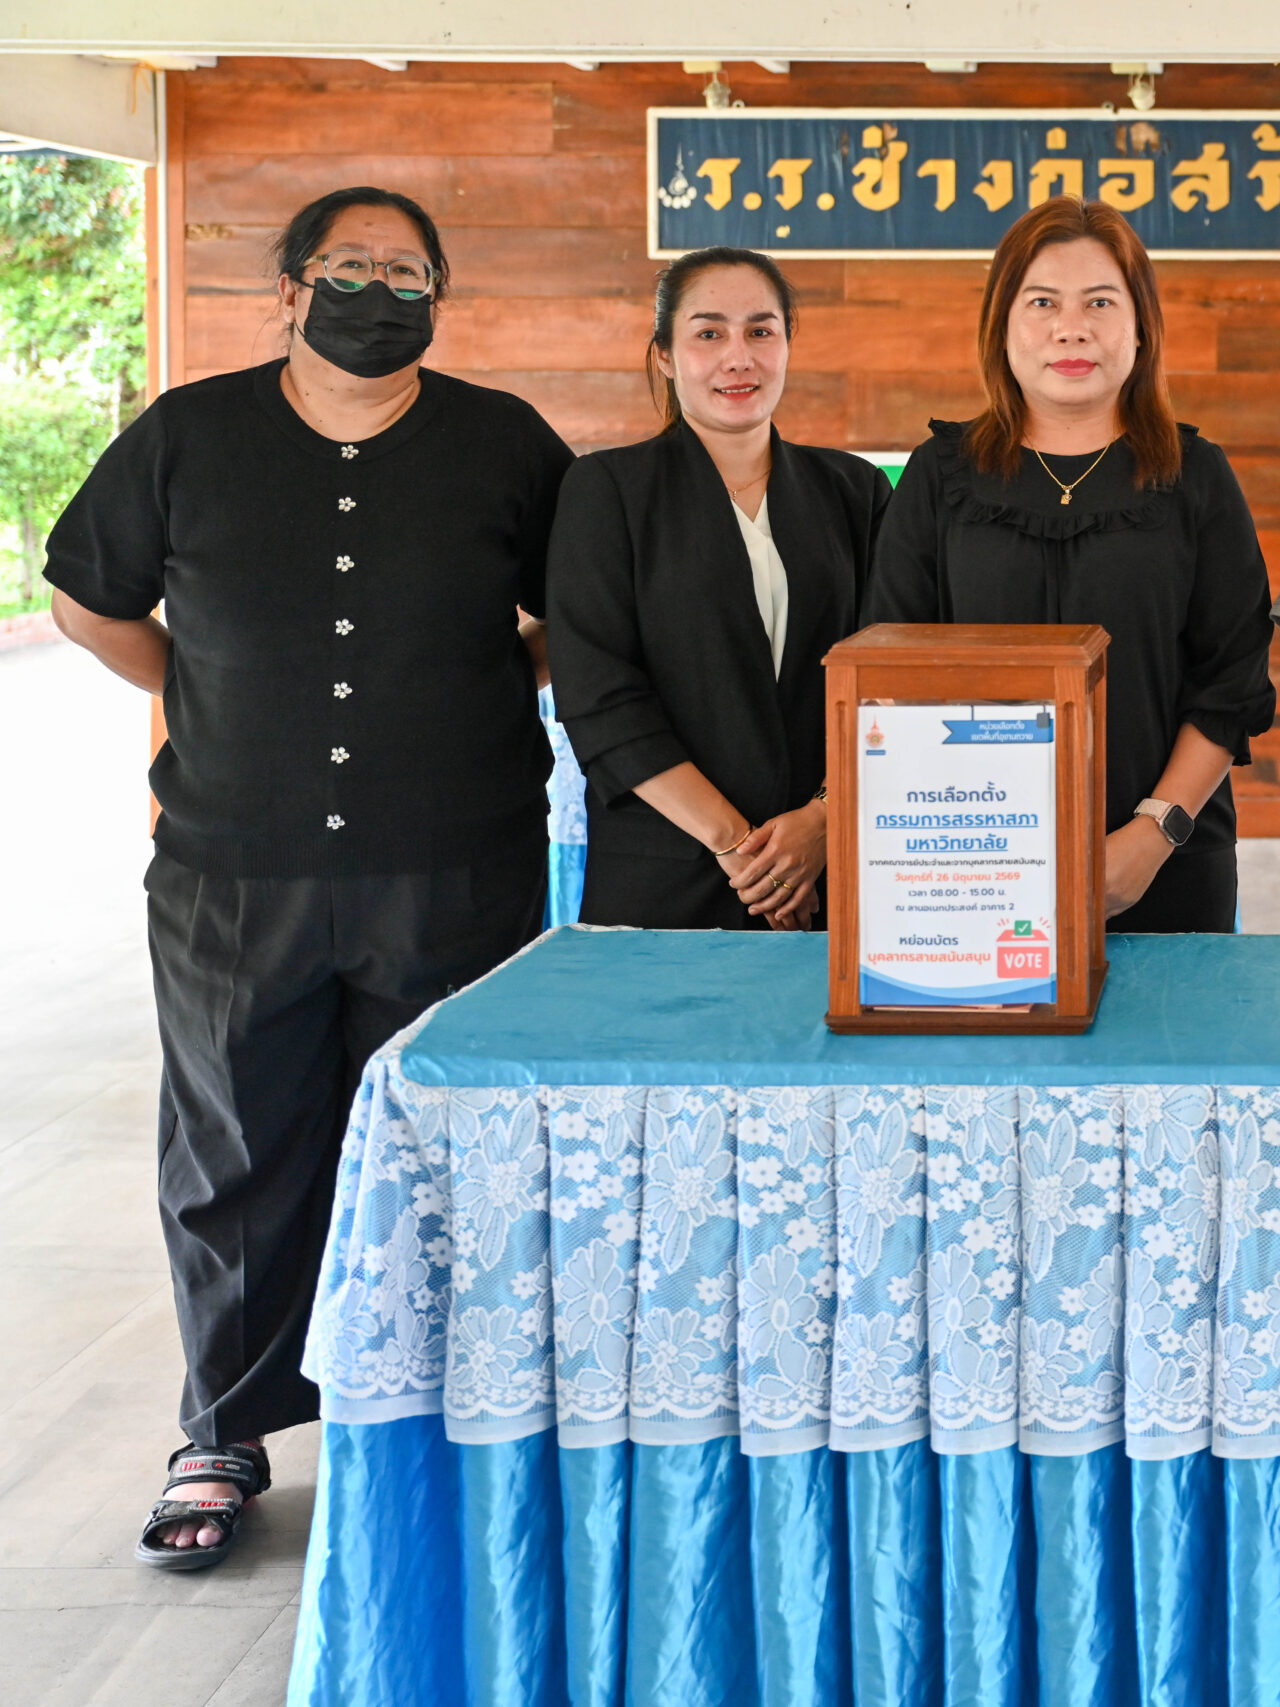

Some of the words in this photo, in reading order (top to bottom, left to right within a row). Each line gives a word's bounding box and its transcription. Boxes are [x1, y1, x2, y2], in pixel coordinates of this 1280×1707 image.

[907, 781, 1007, 803] การเลือกตั้ง
[876, 812, 1039, 829] กรรมการสรรหาสภา
[906, 833, 1008, 852] มหาวิทยาลัย
[894, 870, 933, 884] วันศุกร์ที่
[936, 873, 949, 882] 26
[952, 872, 991, 884] มิถุนายน
[995, 872, 1021, 881] 2569
[908, 889, 928, 897] เวลา
[998, 888, 1007, 896] น.
[895, 904, 905, 912] ณ
[907, 902, 978, 912] ลานอเนกประสงค์
[981, 903, 1006, 911] อาคาร
[899, 934, 959, 946] หย่อนบัตร
[868, 950, 991, 965] บุคลากรสายสนับสนุน
[1004, 953, 1042, 969] VOTE
